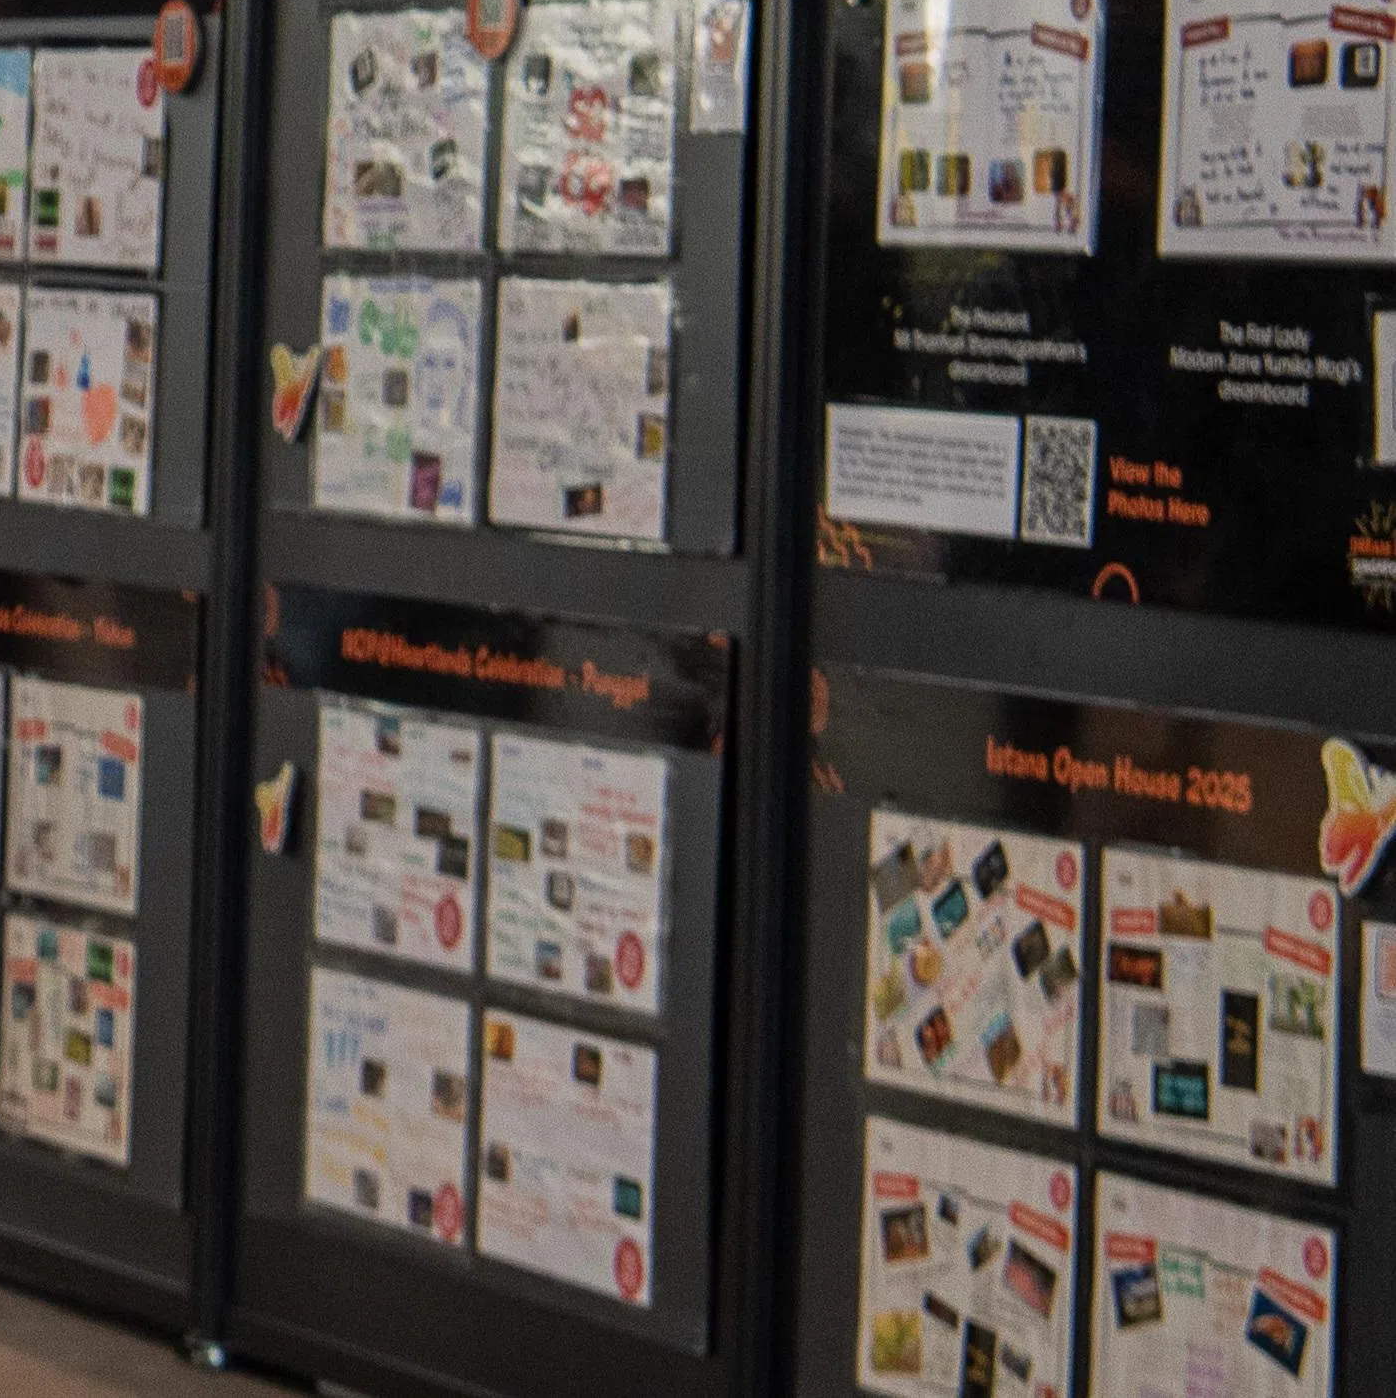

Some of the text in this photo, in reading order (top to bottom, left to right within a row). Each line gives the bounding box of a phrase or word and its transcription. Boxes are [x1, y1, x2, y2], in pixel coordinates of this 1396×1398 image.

[1109, 456, 1183, 490] View the
[1107, 489, 1211, 527] Photos Here
[986, 734, 1253, 815] Istana Open House 2025
